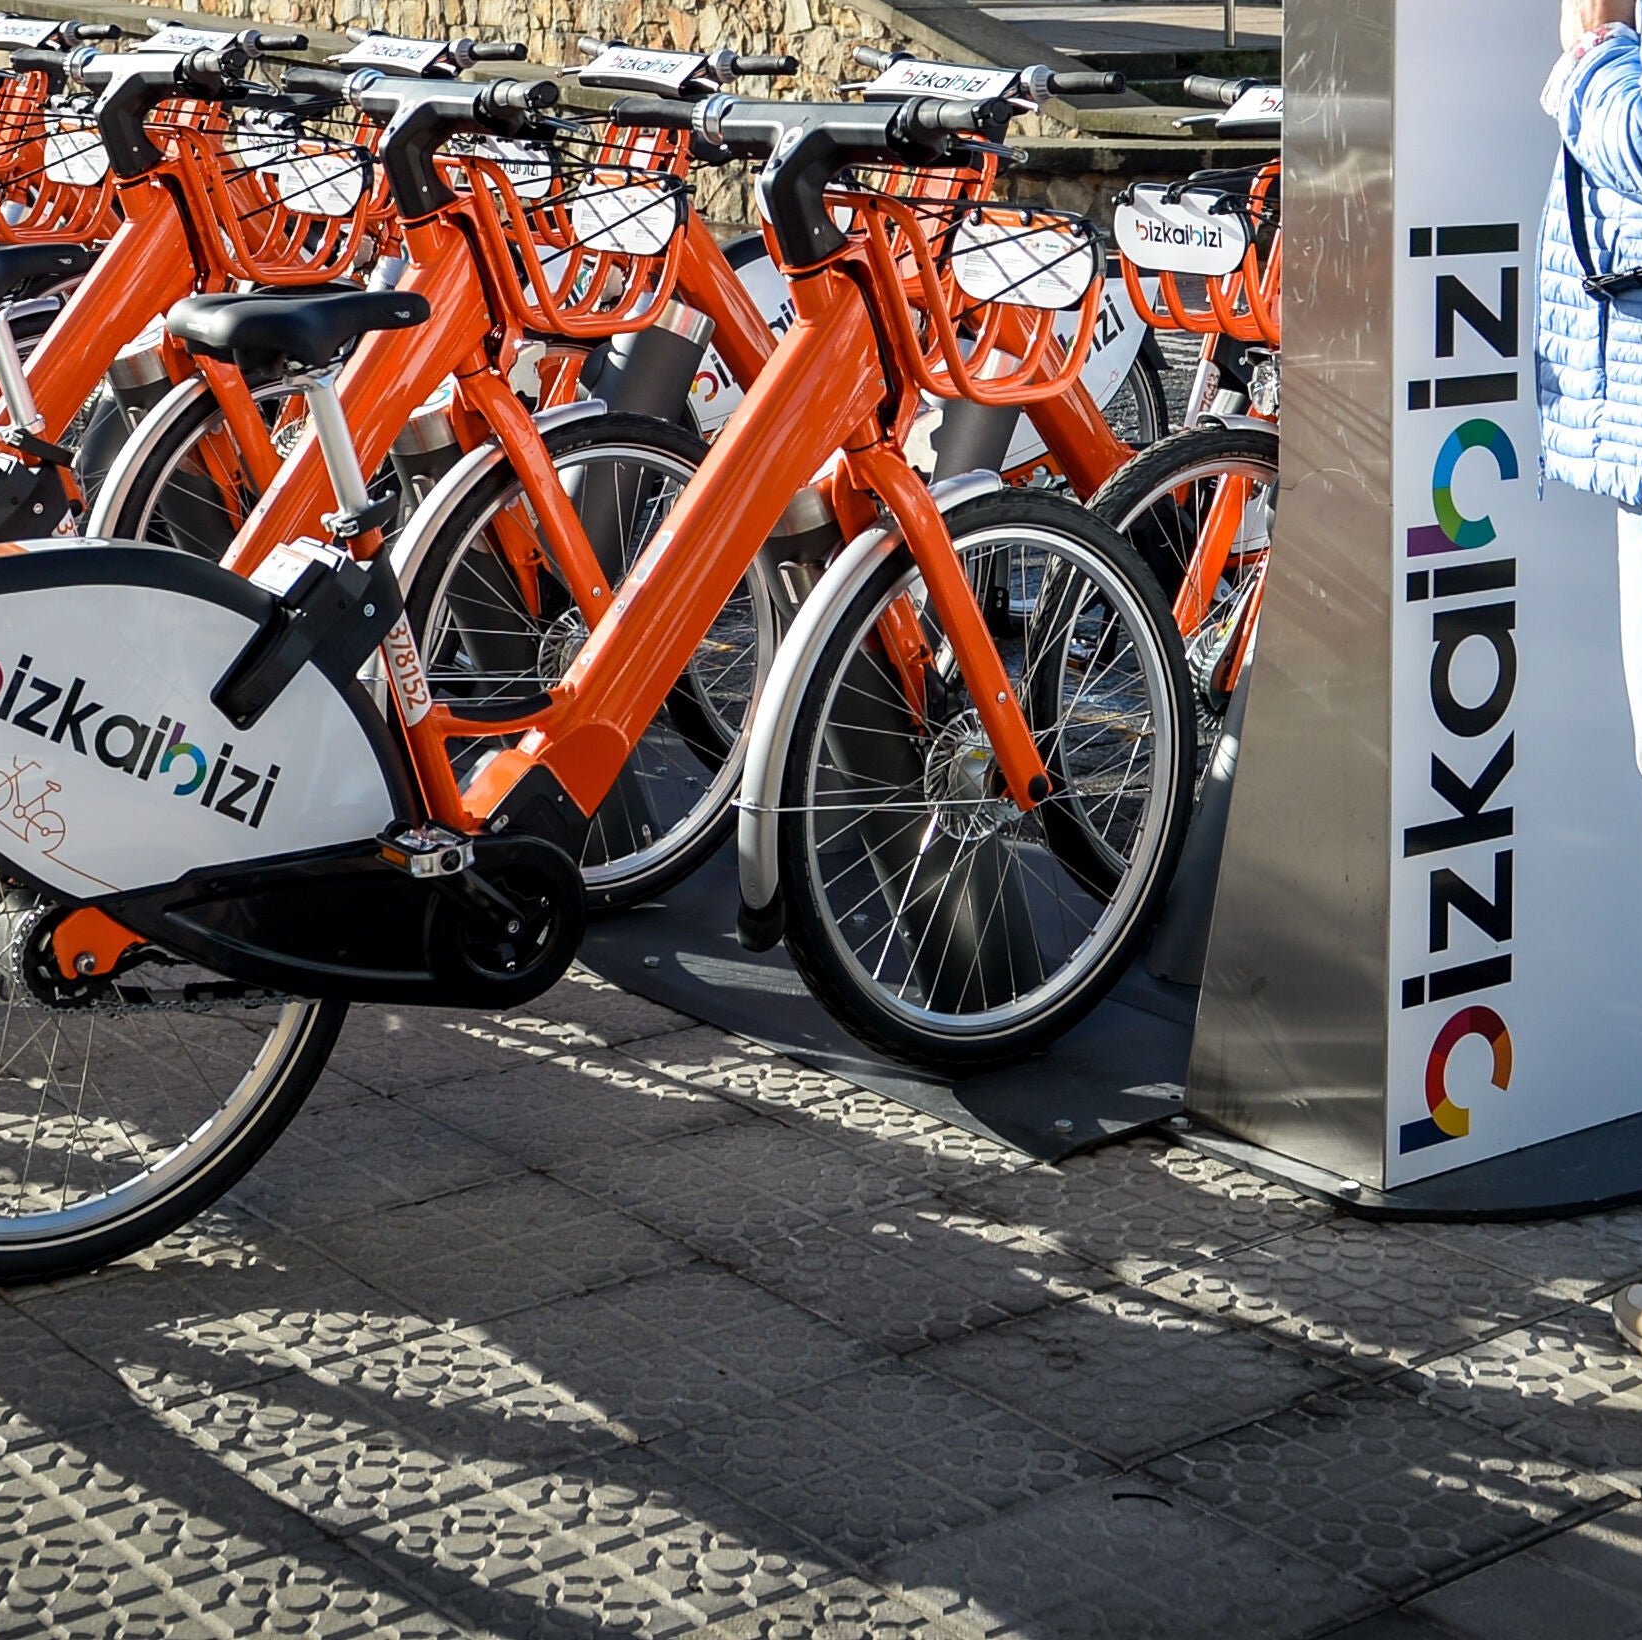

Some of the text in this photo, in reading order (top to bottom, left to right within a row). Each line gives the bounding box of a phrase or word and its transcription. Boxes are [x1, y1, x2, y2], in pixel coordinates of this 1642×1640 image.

[900, 69, 990, 93] bizkaibizi
[1136, 219, 1223, 249] bizkaibizi
[388, 621, 429, 711] 378152
[1399, 221, 1521, 1155] bizkaibizi
